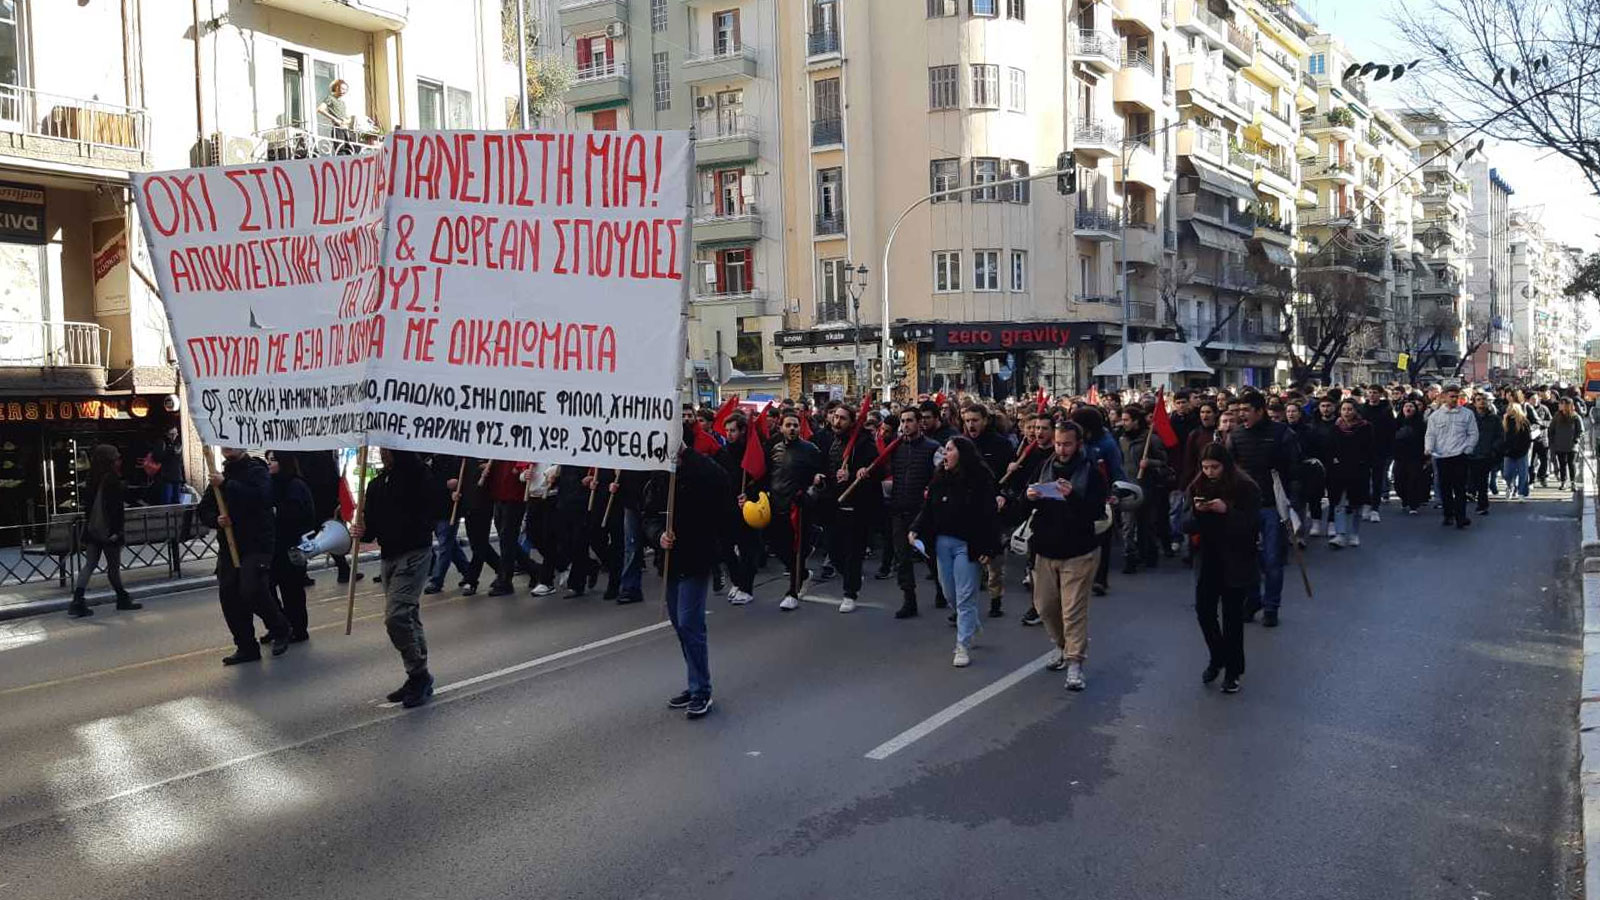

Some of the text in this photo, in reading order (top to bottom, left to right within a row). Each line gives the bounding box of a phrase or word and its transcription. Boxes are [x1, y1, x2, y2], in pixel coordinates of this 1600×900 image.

[143, 173, 217, 237] ΟΧΙ
[224, 166, 295, 231] ΣΤΑ
[168, 234, 322, 293] ΑΠΟΚΛΕΙΣΤΙΚΑ
[396, 214, 415, 261] &
[429, 215, 540, 272] ΔΩΡΕΑΝ
[552, 218, 682, 280] ΣΠΟΥΔΕΣ
[187, 337, 260, 378] ΠΤΥΧΙΑ
[266, 333, 290, 374] ΜΕ
[293, 327, 323, 371] ΑΞΙΑ
[403, 317, 439, 362] ΜΕ
[448, 319, 617, 373] ΔΙΚΑΙΩΜΑΤΑ
[948, 329, 992, 344] zero
[1001, 326, 1071, 347] gravity
[0, 400, 119, 421] RSTOWN
[610, 393, 674, 421] ΧΗΜΙΚΟ
